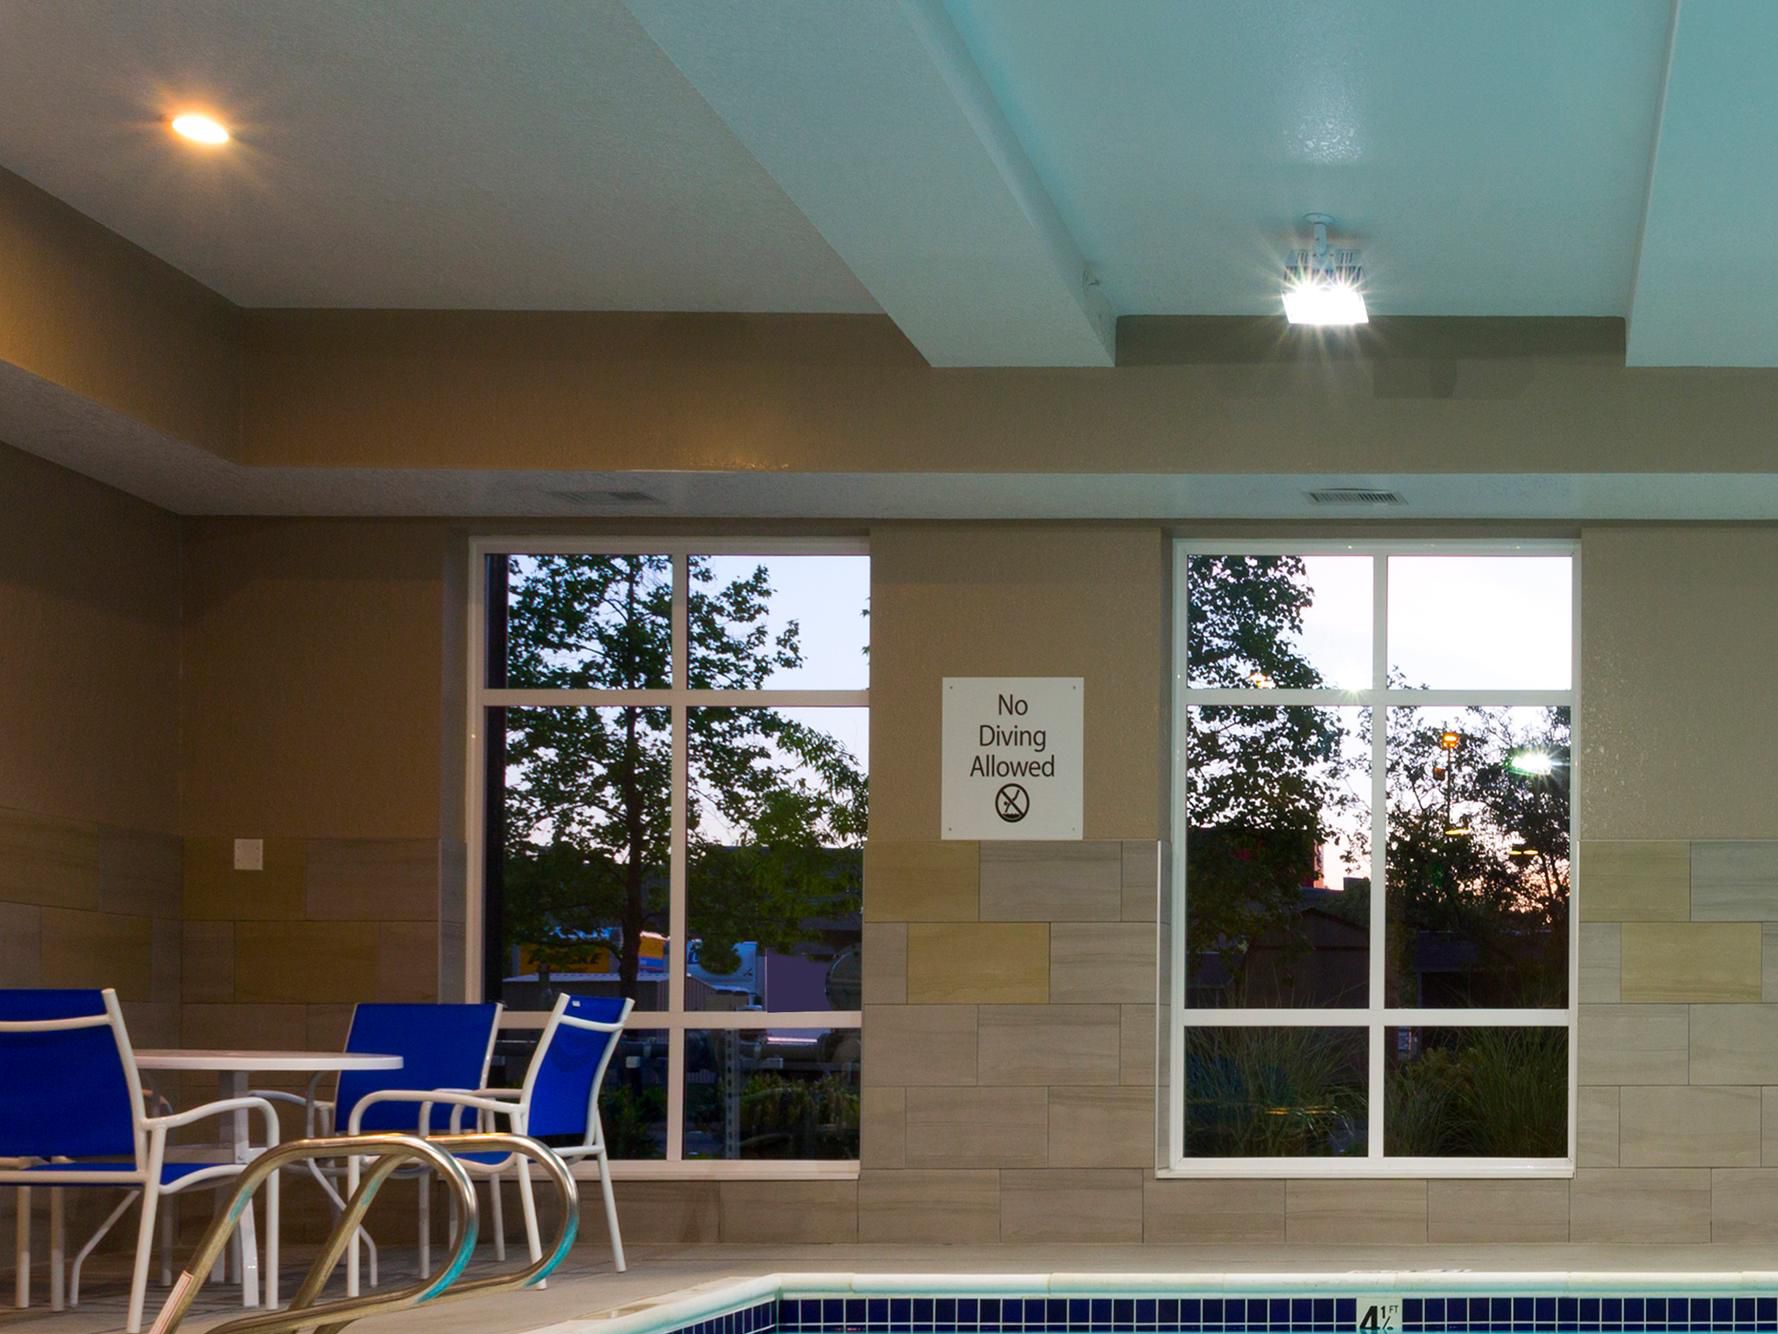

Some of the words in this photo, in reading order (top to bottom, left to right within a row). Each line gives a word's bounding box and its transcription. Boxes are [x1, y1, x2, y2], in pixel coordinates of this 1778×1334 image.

[998, 694, 1029, 716] No
[979, 725, 1047, 753] Diving
[969, 754, 1055, 778] Allowed
